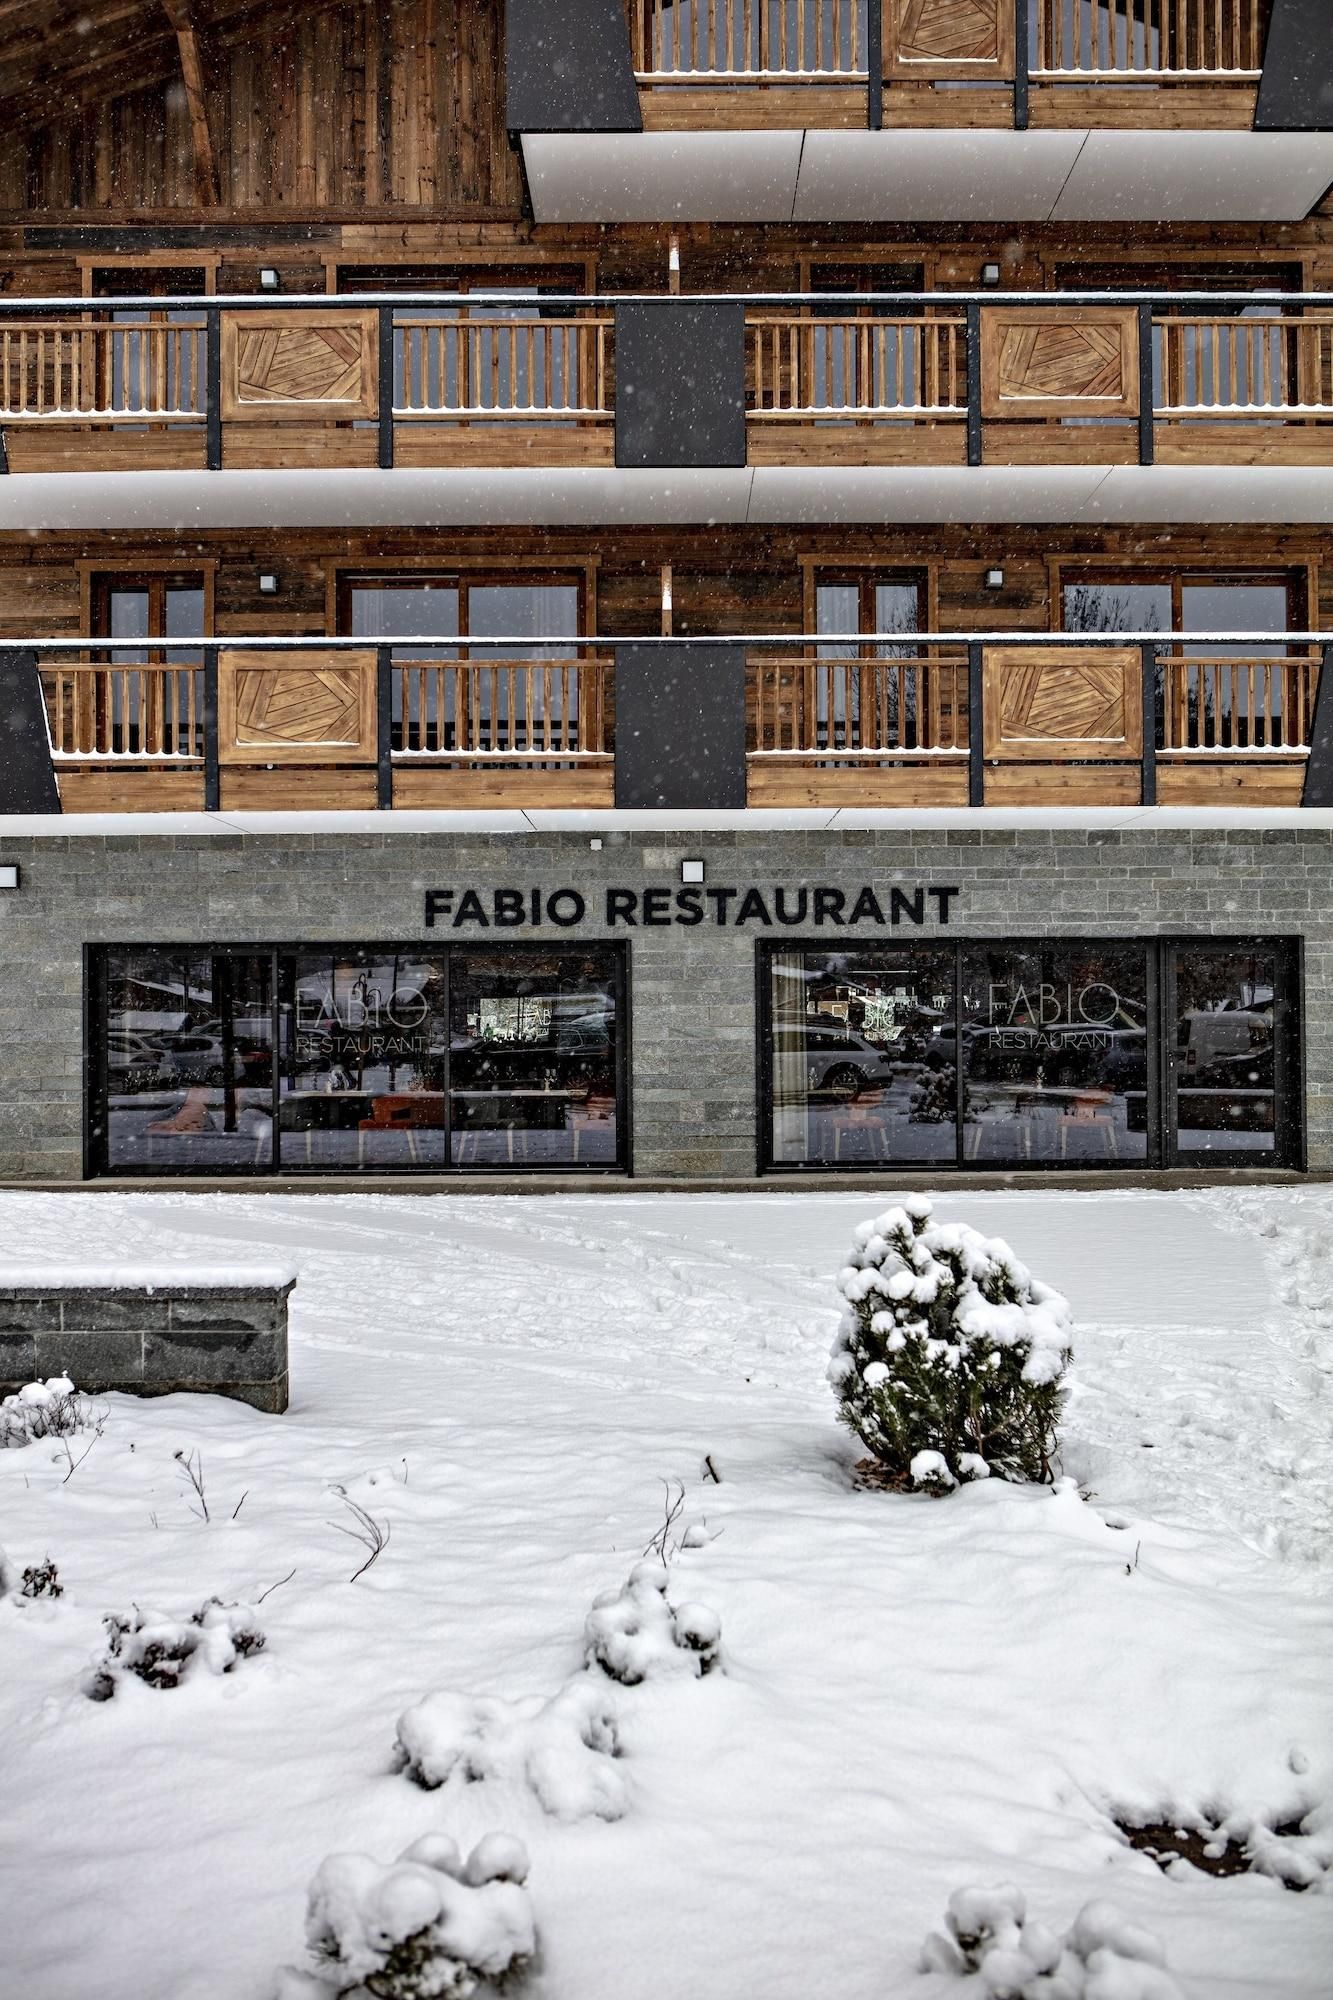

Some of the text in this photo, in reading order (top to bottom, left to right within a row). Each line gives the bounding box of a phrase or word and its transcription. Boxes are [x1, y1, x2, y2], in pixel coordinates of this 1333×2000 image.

[424, 887, 959, 927] FABIO RESTAURANT
[297, 987, 428, 1031] FABIO
[988, 983, 1120, 1025] FABIO
[296, 1036, 428, 1053] RESTAURANT
[988, 1032, 1117, 1049] RESTAURANT
